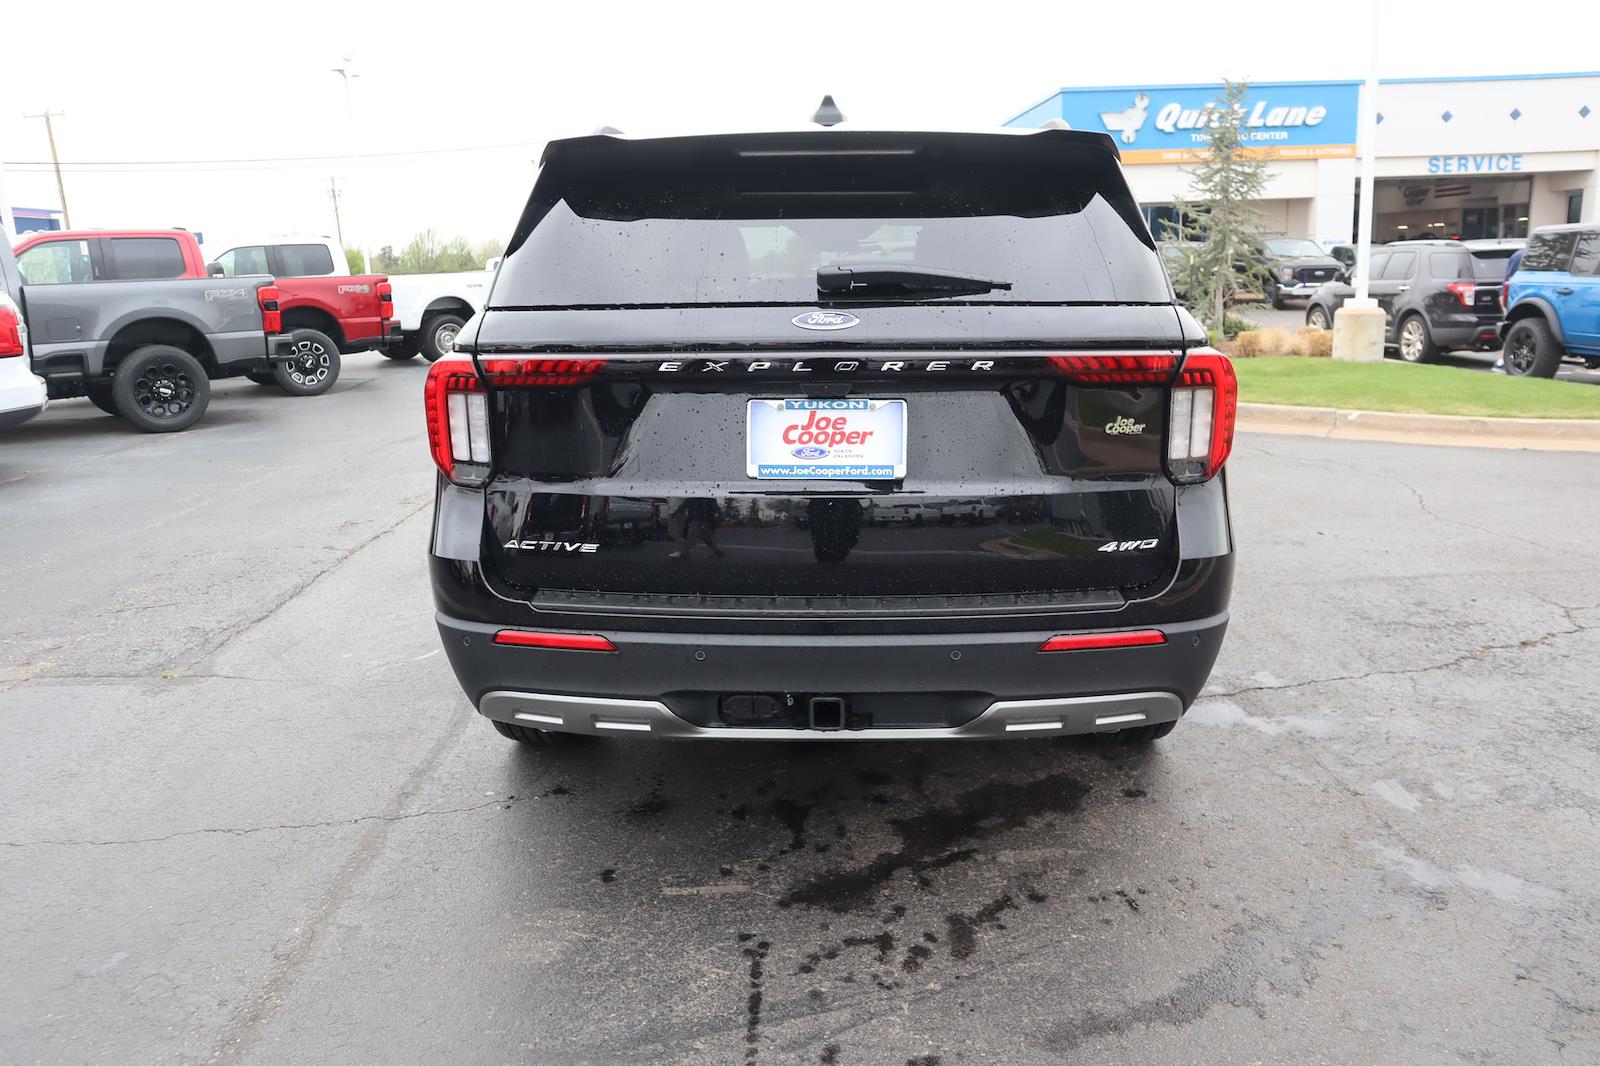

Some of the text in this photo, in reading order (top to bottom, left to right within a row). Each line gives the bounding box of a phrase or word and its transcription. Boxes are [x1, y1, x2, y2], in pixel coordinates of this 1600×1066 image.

[1246, 101, 1327, 127] Lane
[1250, 131, 1288, 140] CENTER
[1428, 154, 1523, 173] SERVICE
[205, 288, 247, 300] FX4
[808, 313, 846, 326] Ford
[658, 361, 995, 372] EXPLORER
[790, 400, 864, 409] YUKON
[801, 410, 847, 430] Joe
[1114, 416, 1135, 426] Joe
[1105, 423, 1146, 434] Cooper
[782, 424, 873, 447] Cooper
[760, 466, 892, 477] www.JoeCooperFord.com
[503, 540, 600, 553] ACTIVE
[1098, 539, 1159, 552] 4WD
